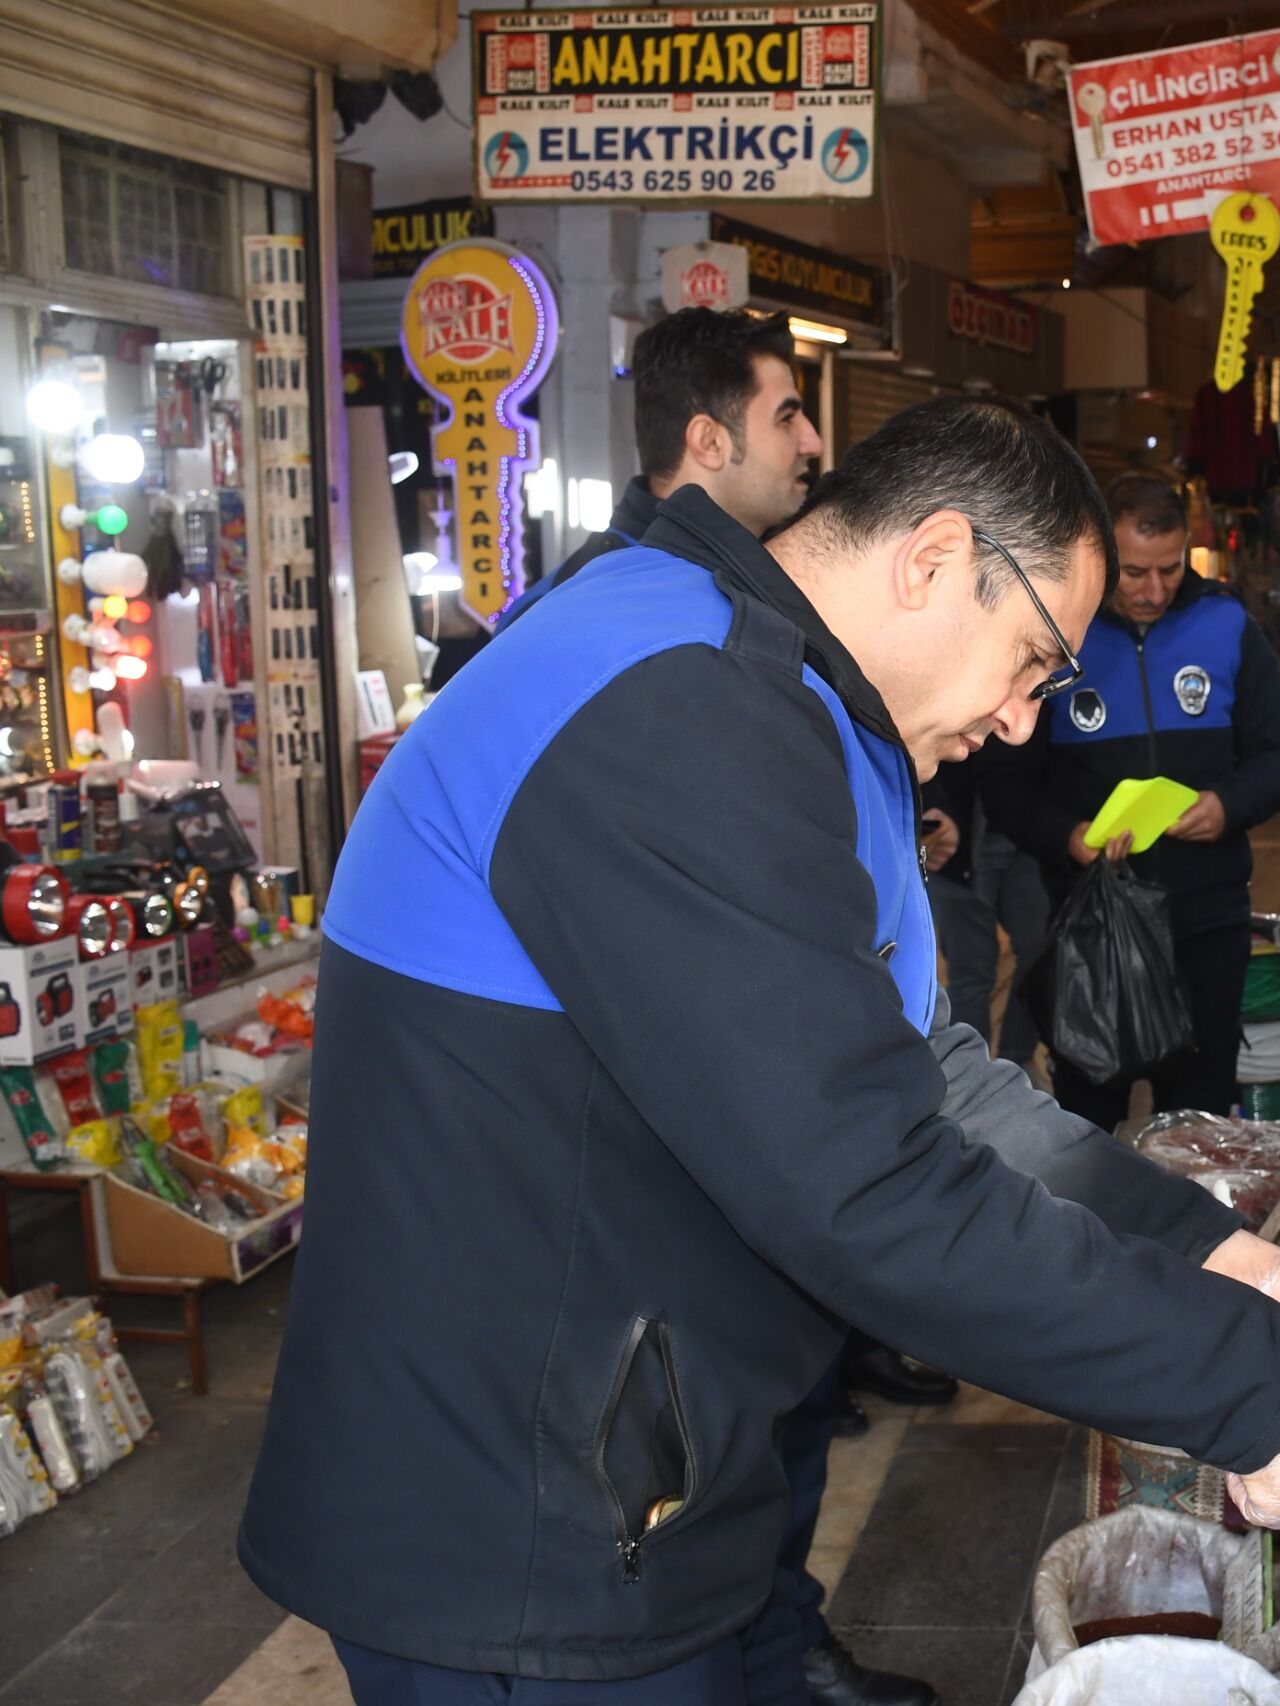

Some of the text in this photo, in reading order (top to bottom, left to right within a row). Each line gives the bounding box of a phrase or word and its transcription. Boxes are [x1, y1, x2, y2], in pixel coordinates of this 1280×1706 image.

[552, 30, 799, 86] ANAHTARCI
[1110, 55, 1269, 113] ÇİLİNGİRCİ
[539, 116, 813, 170] ELEKTRİKÇİ
[1113, 104, 1277, 148] ERHAN USTA
[571, 170, 633, 192] 0543
[644, 170, 691, 191] 625
[701, 170, 732, 191] 90
[743, 170, 775, 191] 26
[1106, 152, 1165, 178] 0541
[1174, 143, 1217, 168] 382
[1225, 136, 1254, 157] 52
[1157, 167, 1251, 194] ANAHTARCI
[464, 388, 492, 598] ANAHTARCI
